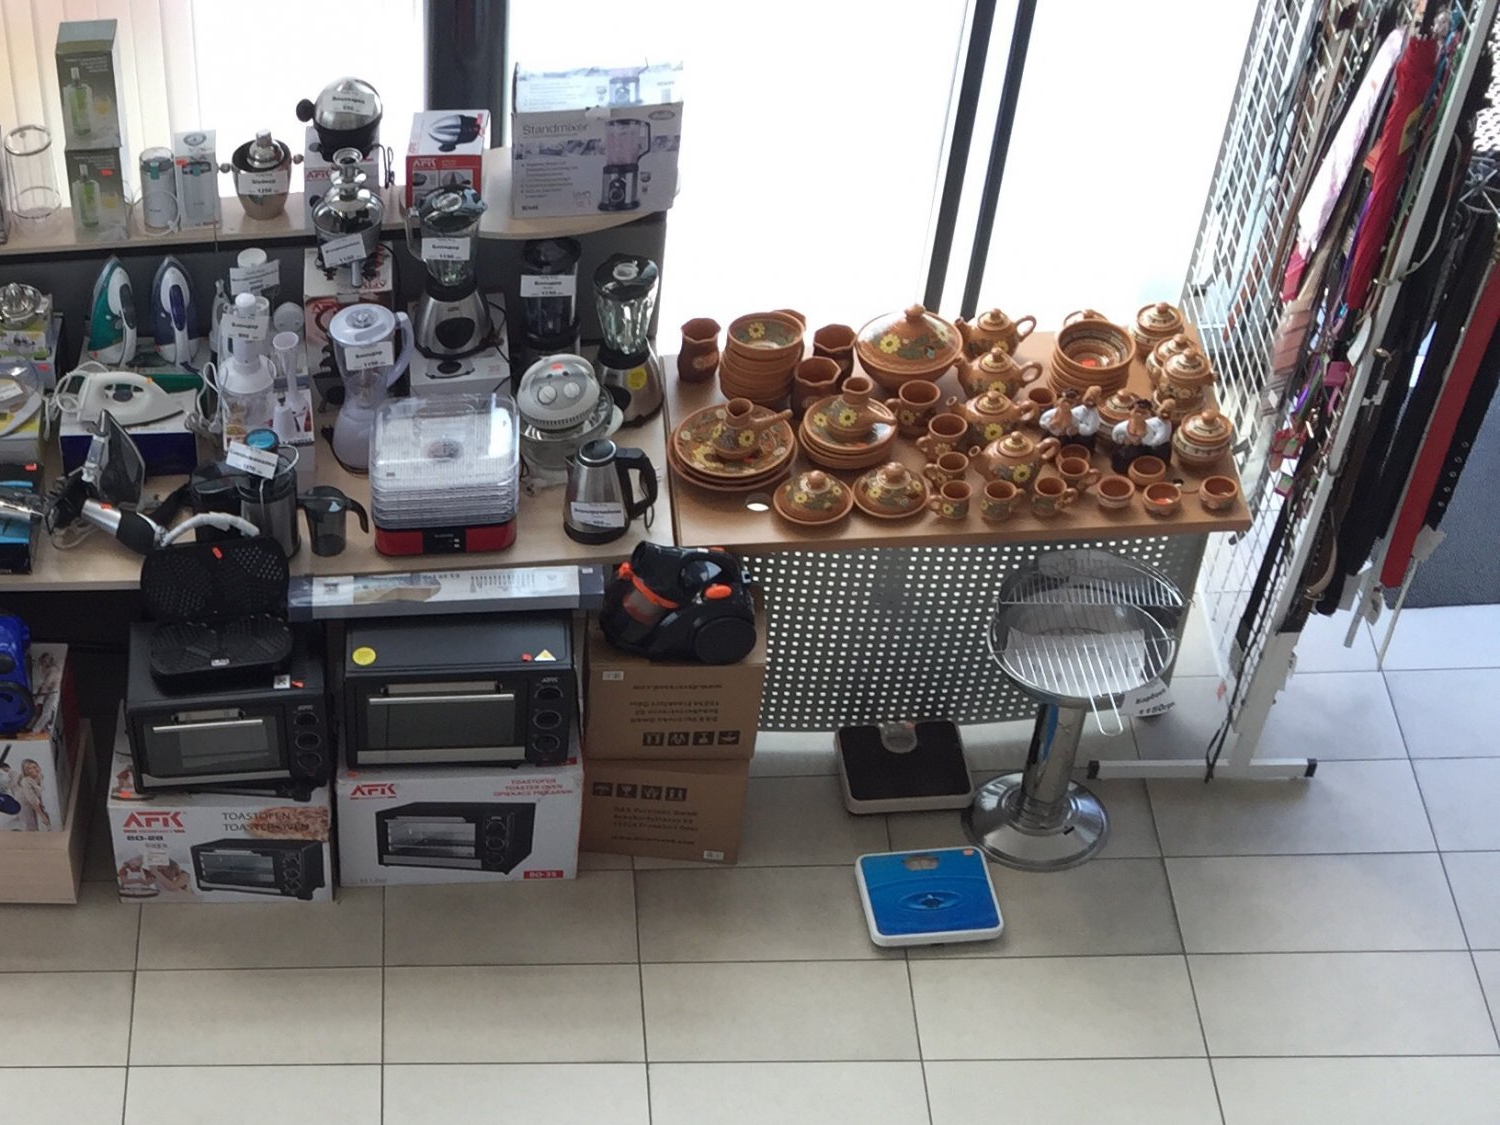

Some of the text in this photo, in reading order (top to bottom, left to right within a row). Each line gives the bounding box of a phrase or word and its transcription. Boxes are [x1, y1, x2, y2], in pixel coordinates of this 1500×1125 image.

[522, 122, 589, 136] Standmixer
[350, 783, 397, 797] AFK
[122, 810, 292, 829] AFK TOASTOFEN
